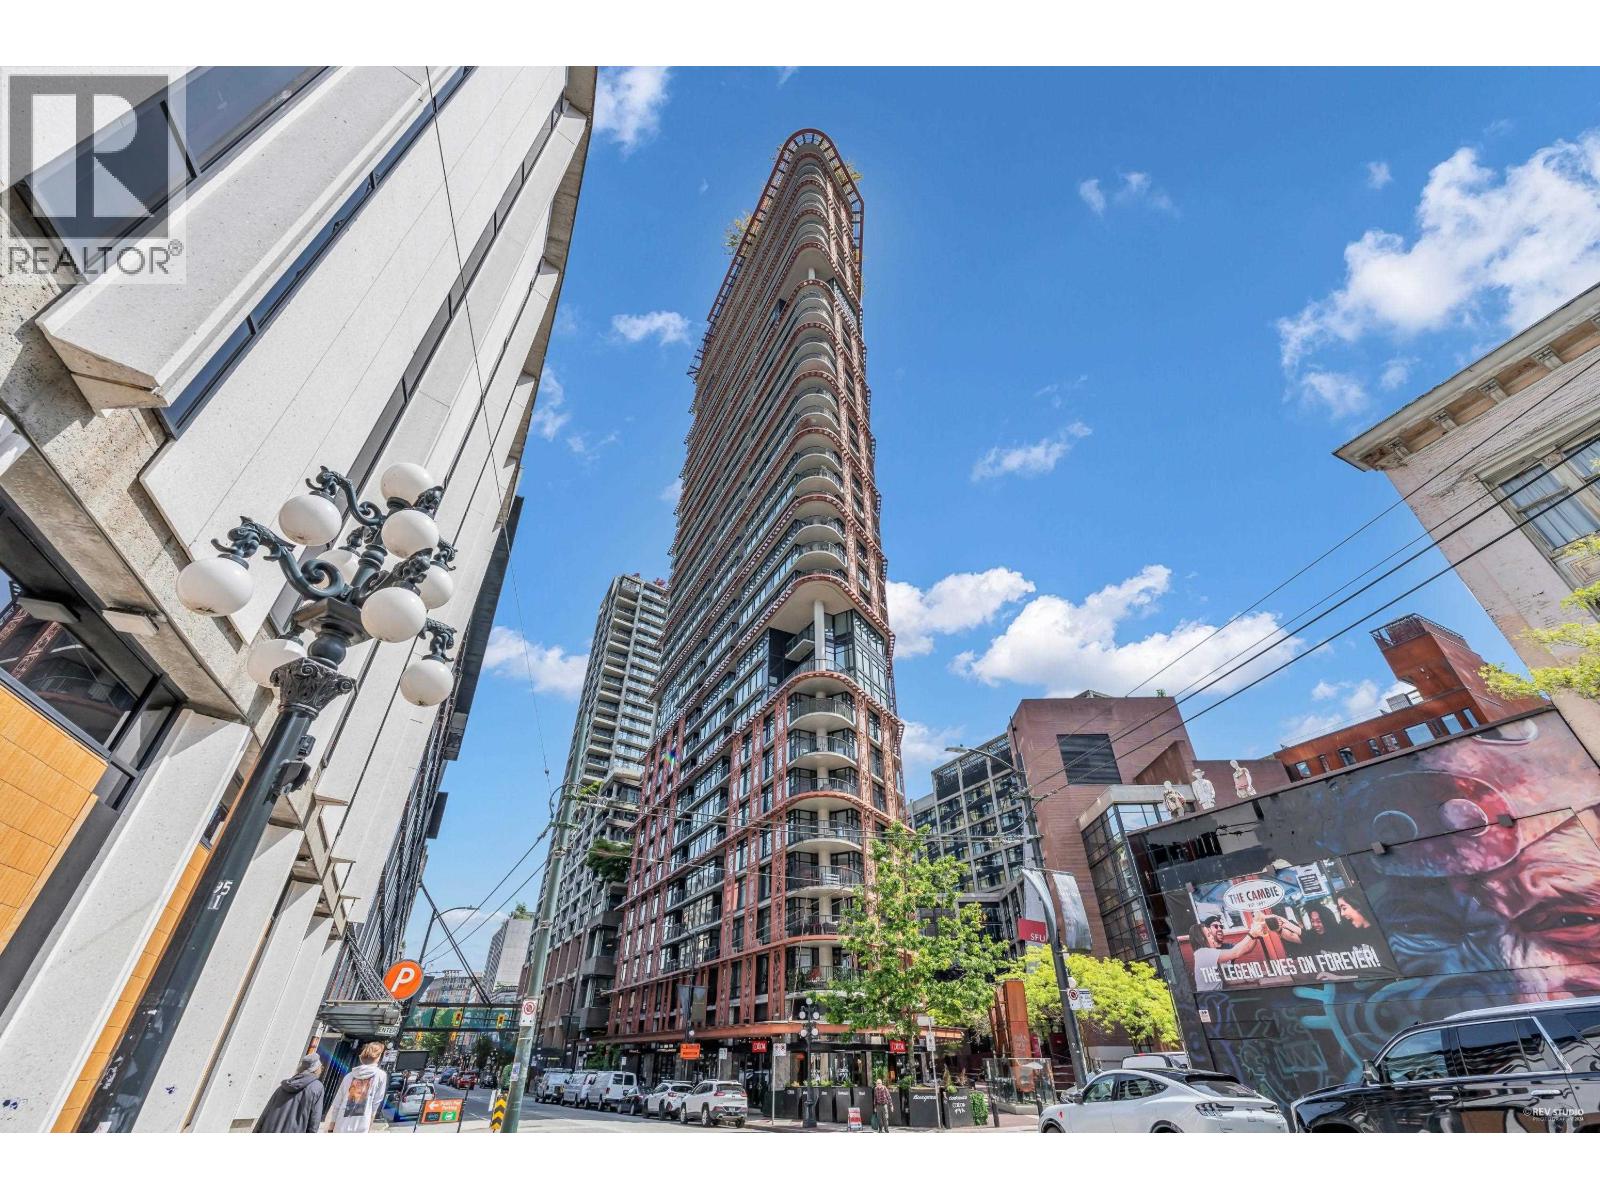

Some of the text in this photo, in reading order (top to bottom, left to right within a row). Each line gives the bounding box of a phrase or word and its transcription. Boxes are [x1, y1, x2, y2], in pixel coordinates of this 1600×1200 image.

[1228, 892, 1245, 904] THE
[1246, 886, 1280, 901] CAMBIE
[1200, 948, 1381, 983] THE LEGEND LIVES ON FOREVER!
[390, 967, 415, 993] P
